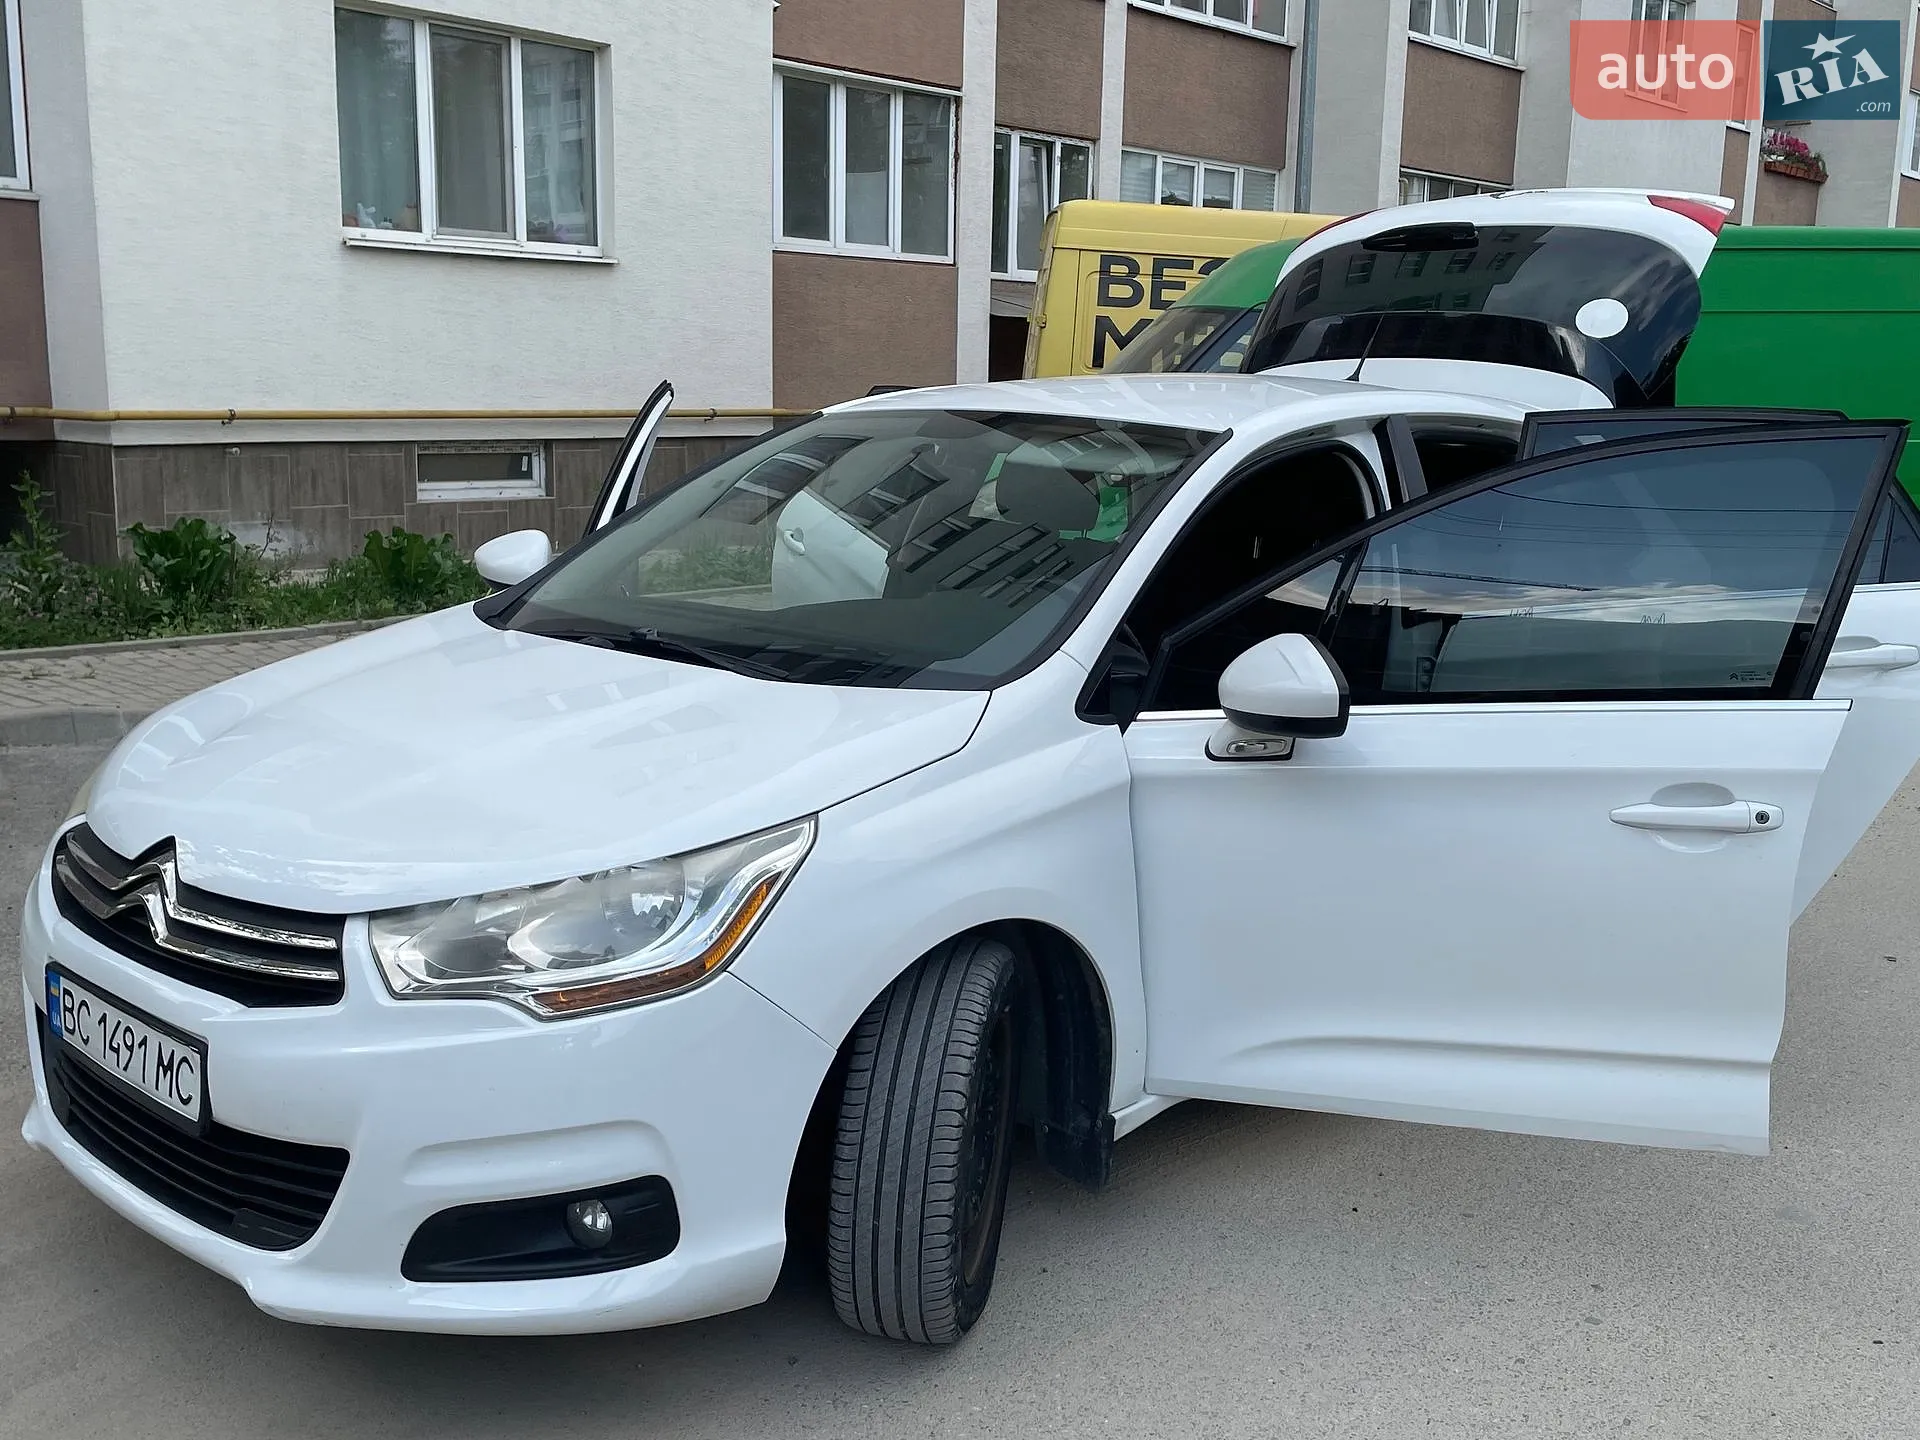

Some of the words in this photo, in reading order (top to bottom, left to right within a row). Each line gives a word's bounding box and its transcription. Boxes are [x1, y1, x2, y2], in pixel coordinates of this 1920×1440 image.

[62, 986, 93, 1046] BC
[97, 1012, 149, 1085] 1491
[154, 1041, 195, 1106] MC
